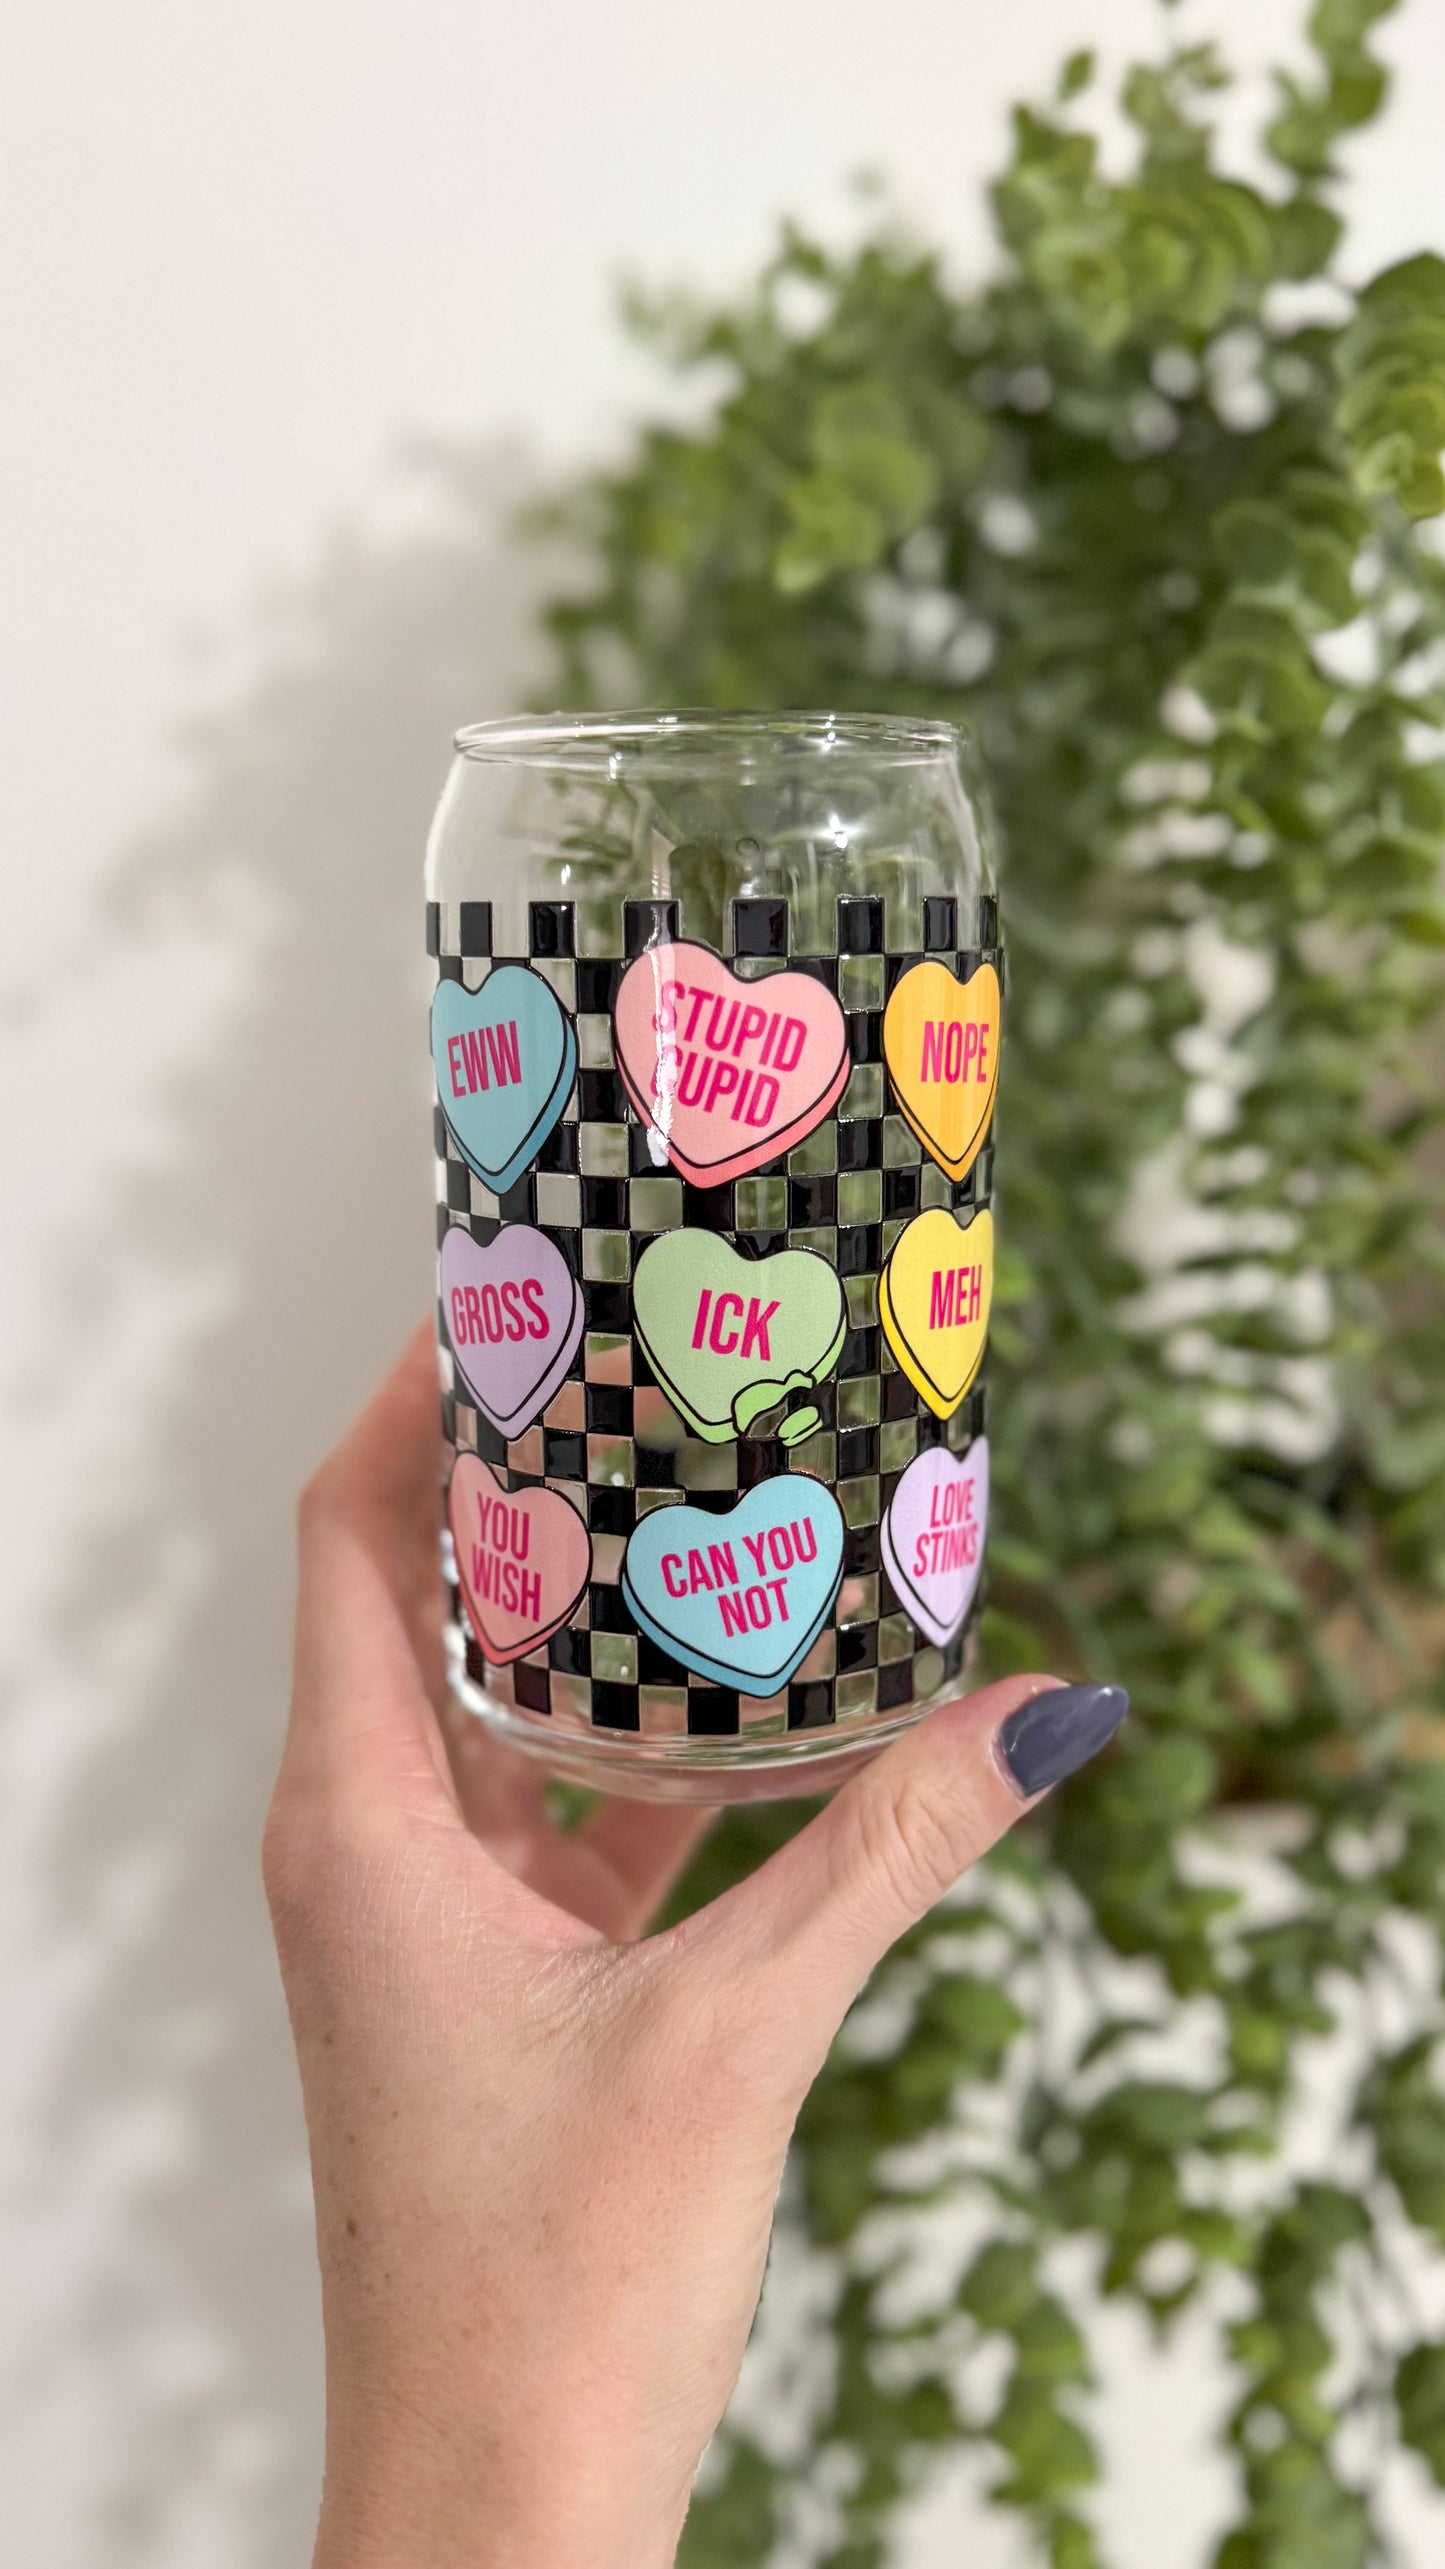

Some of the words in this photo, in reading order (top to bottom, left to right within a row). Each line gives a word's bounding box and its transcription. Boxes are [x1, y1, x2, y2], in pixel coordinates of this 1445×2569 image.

[448, 1020, 521, 1098] EWW
[652, 979, 808, 1073] STUPID
[921, 1021, 989, 1083] NOPE
[451, 1278, 550, 1345] GROSS
[691, 1289, 781, 1361] ICK
[929, 1264, 982, 1330] MEH
[477, 1491, 530, 1562] YOU
[930, 1477, 975, 1528] LOVE
[472, 1544, 542, 1623] WISH
[661, 1541, 740, 1599] CAN
[742, 1517, 818, 1577] YOU
[912, 1521, 979, 1578] STINKS
[717, 1577, 790, 1637] NOT
